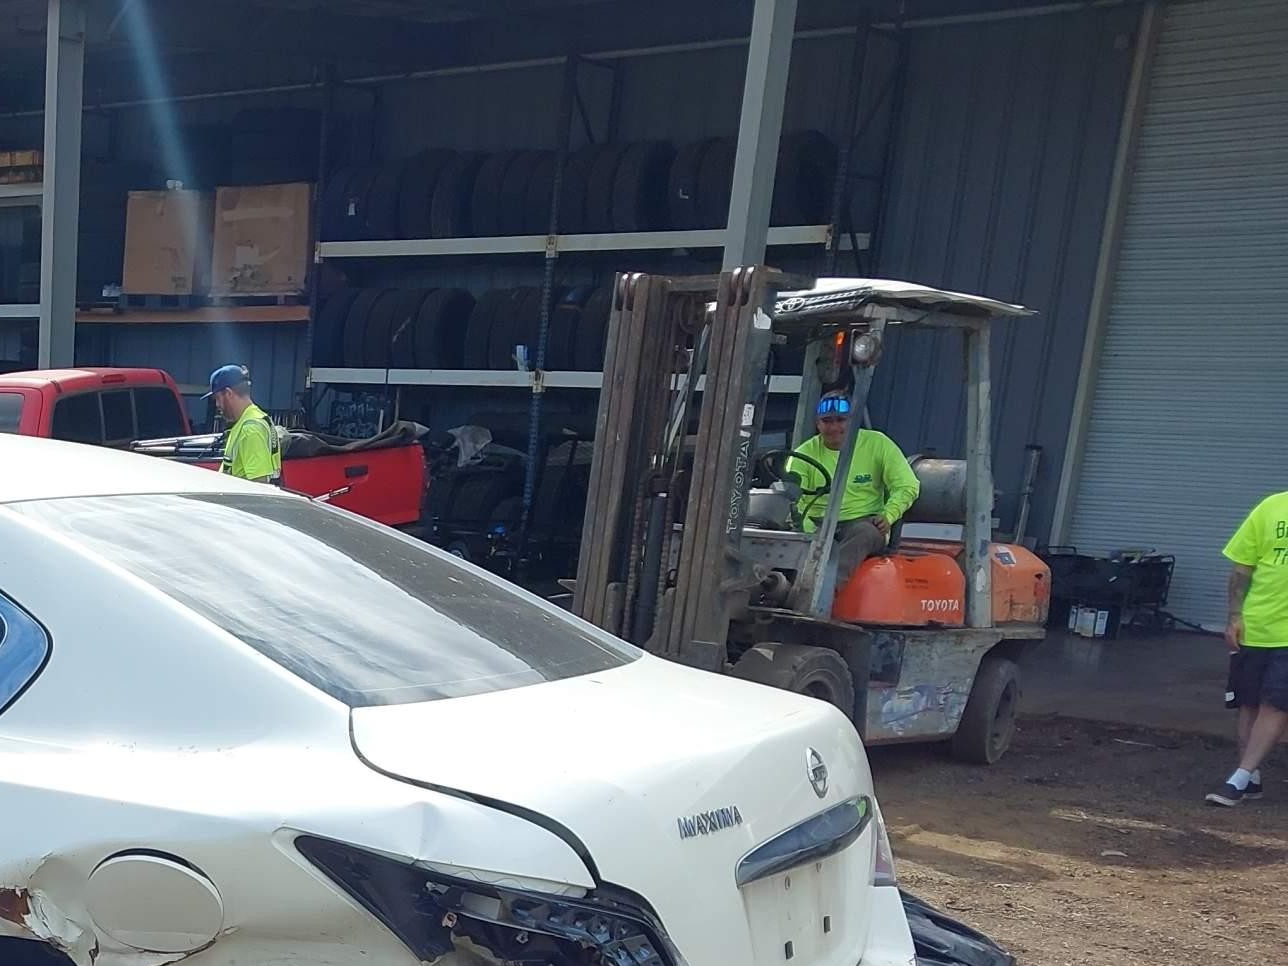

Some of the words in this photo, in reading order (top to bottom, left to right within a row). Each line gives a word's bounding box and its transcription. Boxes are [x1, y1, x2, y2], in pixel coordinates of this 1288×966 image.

[726, 440, 750, 534] TOYOTA
[920, 599, 960, 612] TOYOTA
[677, 805, 744, 840] MAXIMA
